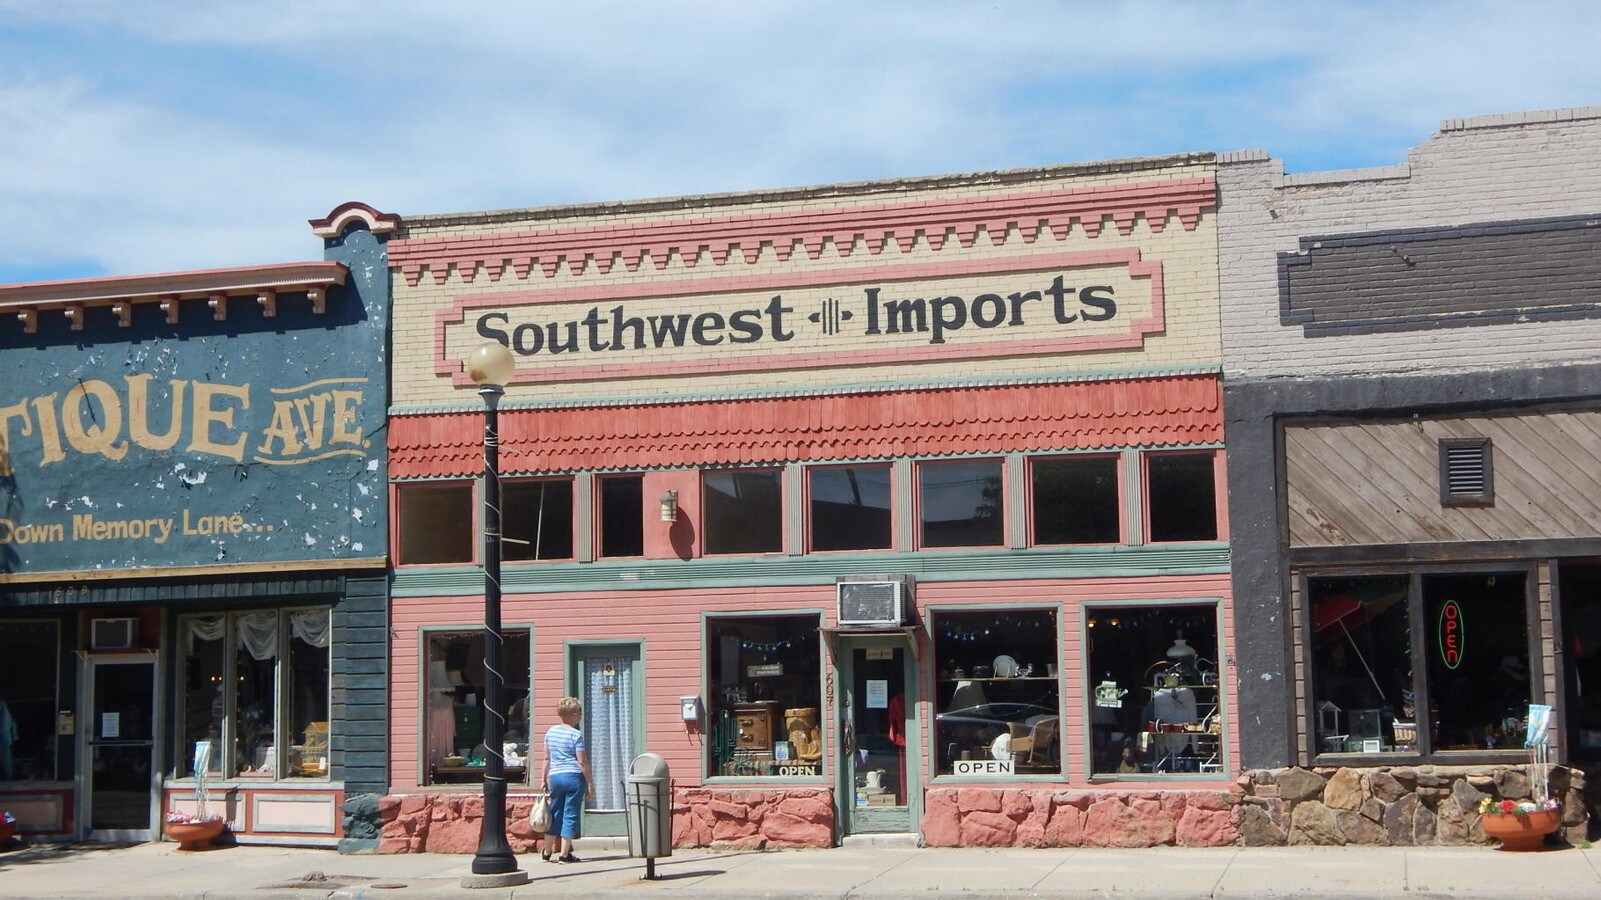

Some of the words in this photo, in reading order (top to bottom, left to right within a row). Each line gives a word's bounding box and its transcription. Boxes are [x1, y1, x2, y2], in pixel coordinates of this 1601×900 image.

[476, 294, 795, 356] Southwest
[864, 274, 1117, 344] Imports
[0, 518, 64, 545] Down
[72, 513, 173, 543] Memory
[779, 765, 816, 777] OPEN
[958, 762, 1010, 773] OPEN
